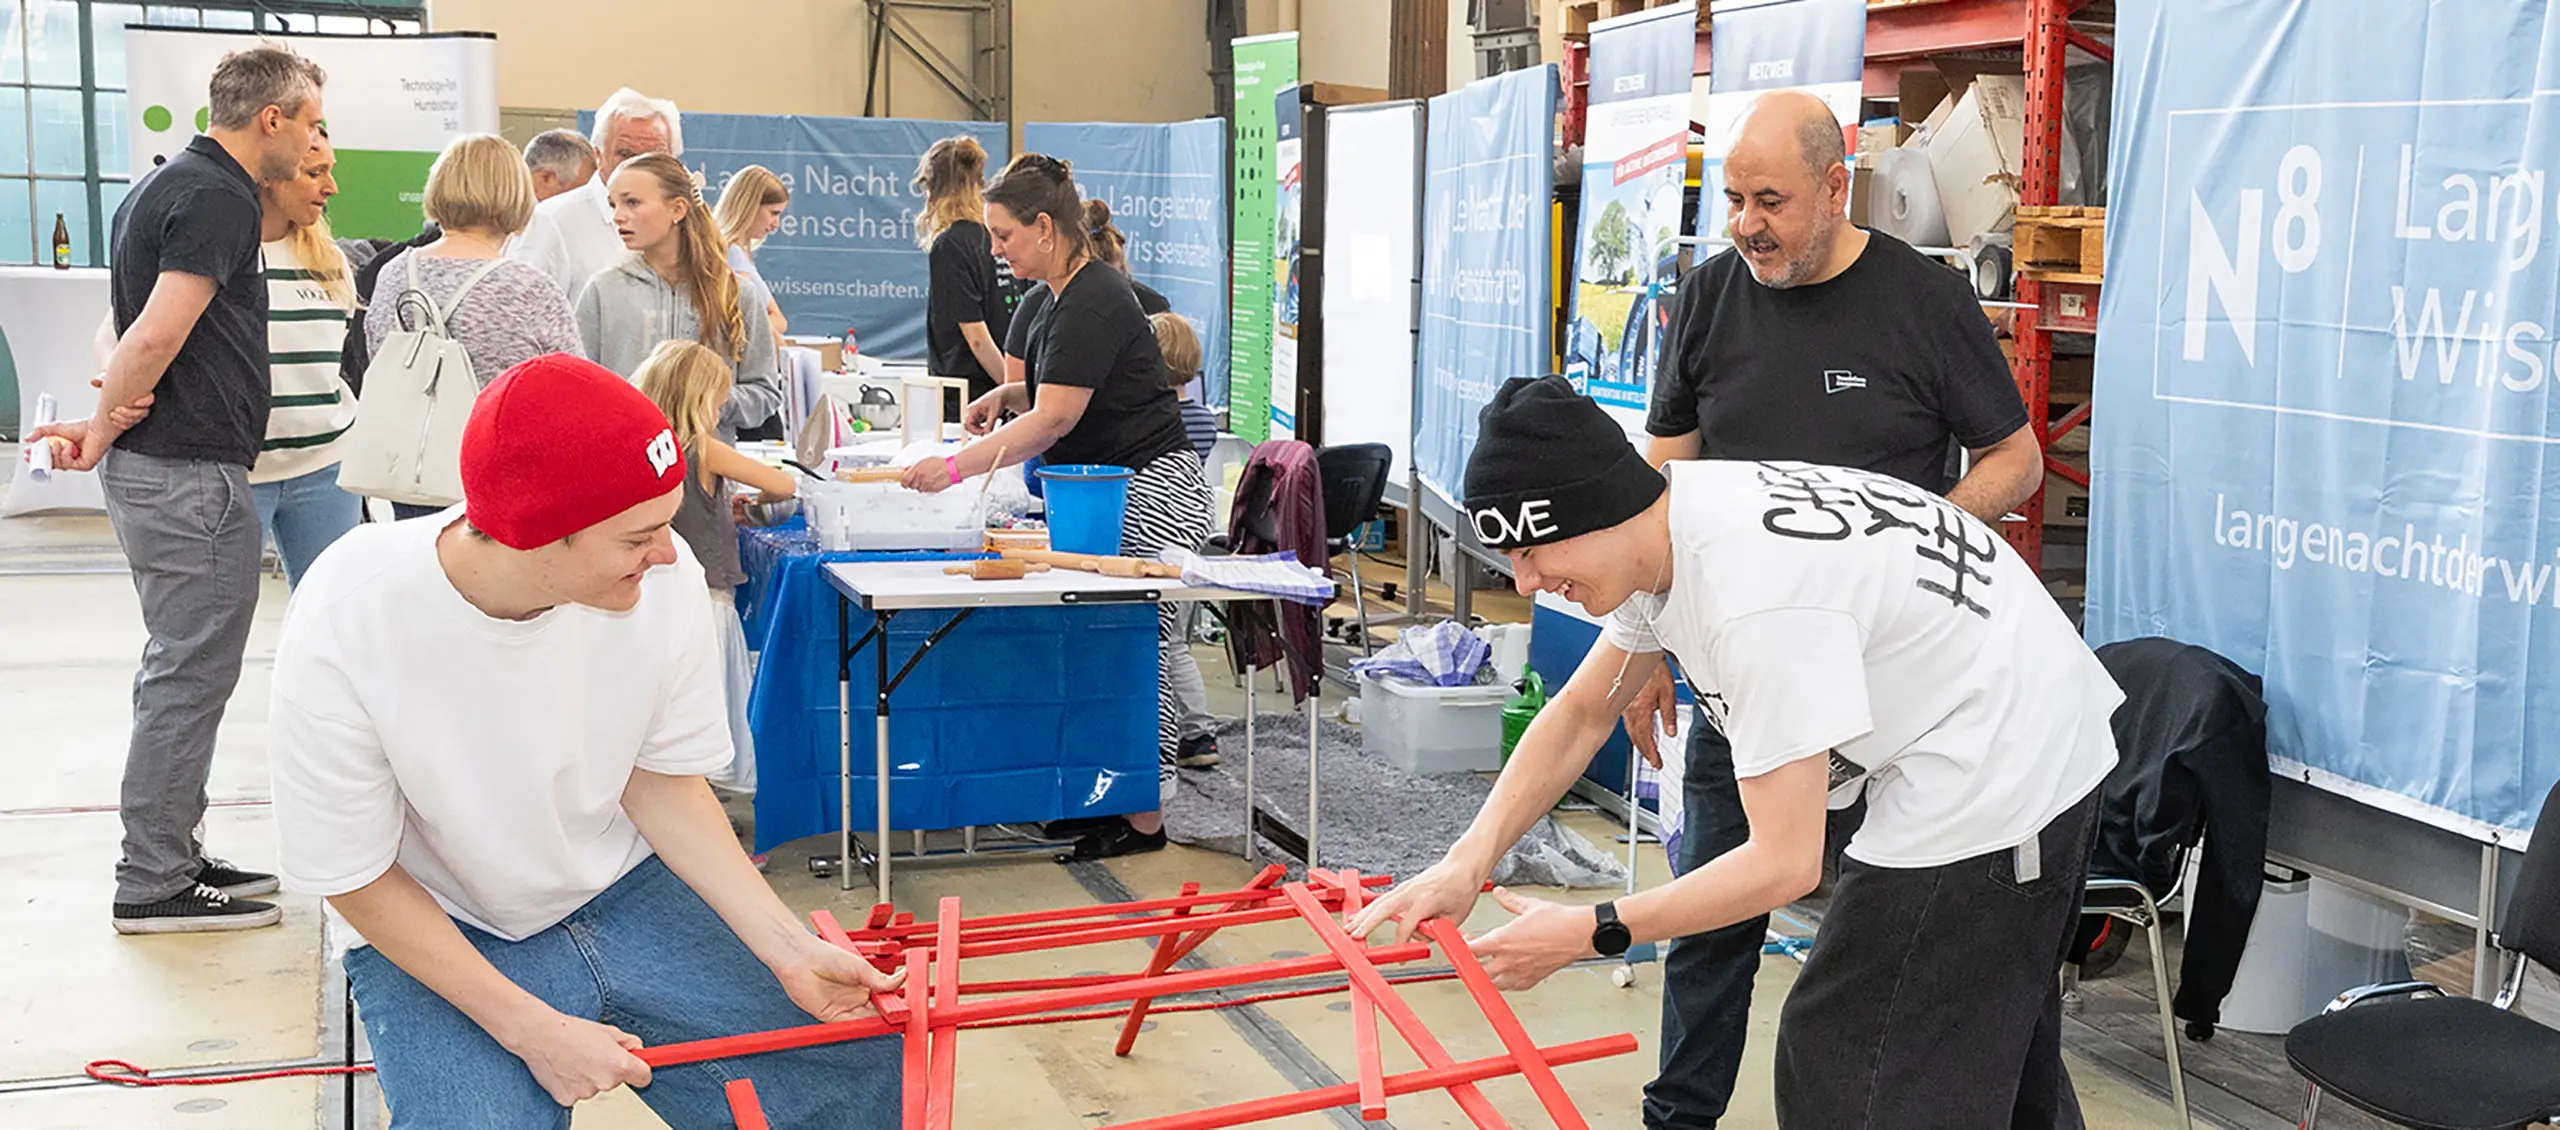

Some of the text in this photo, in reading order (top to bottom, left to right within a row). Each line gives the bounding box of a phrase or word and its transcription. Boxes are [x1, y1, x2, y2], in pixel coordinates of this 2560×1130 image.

[805, 164, 900, 197] Nacht
[2395, 144, 2560, 272] Lang
[1466, 499, 1559, 545] LOVE
[2214, 494, 2560, 610] langenachtderwi
